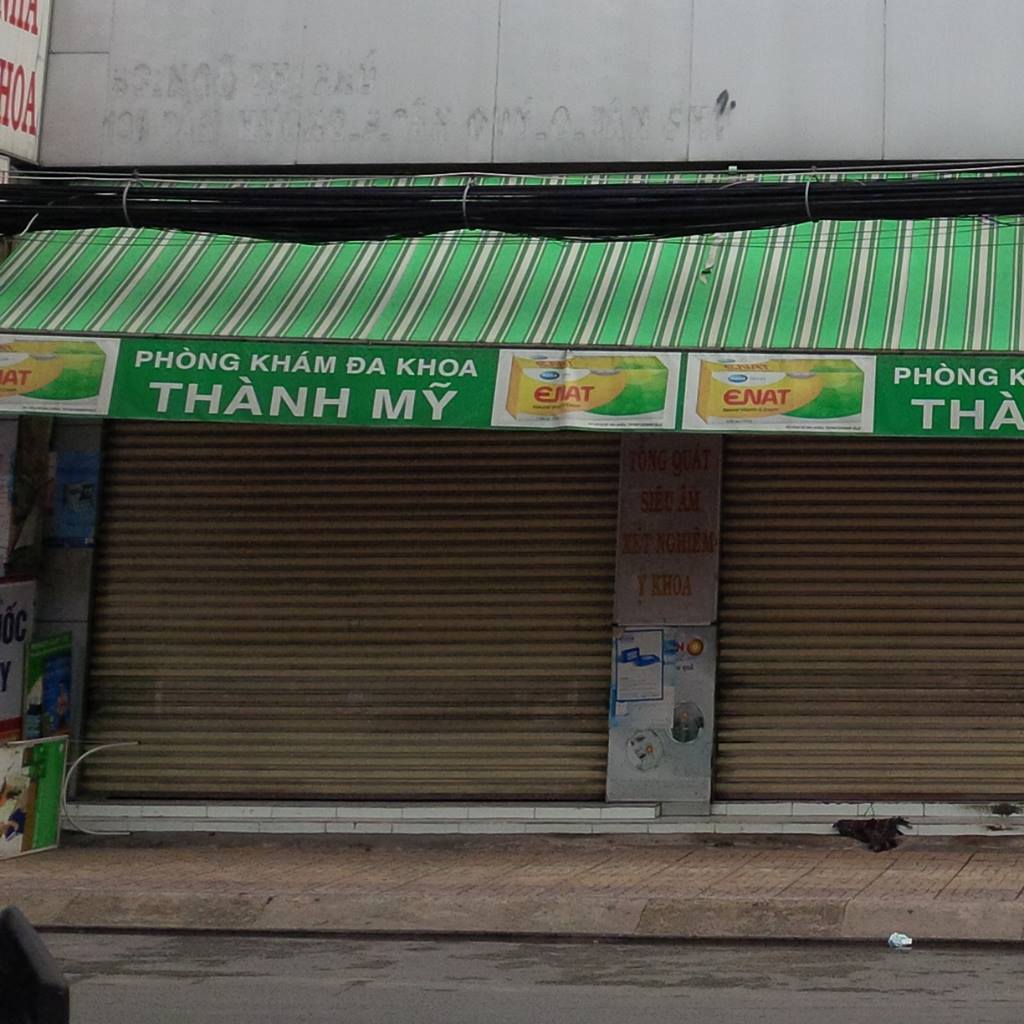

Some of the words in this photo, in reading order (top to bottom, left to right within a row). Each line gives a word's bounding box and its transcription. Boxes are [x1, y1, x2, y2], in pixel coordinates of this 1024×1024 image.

[134, 347, 241, 371] PHÒNG
[250, 351, 337, 374] KHÁM
[346, 357, 386, 375] ĐA
[396, 358, 478, 377] KHOA
[893, 363, 999, 386] PHÒNG
[149, 376, 350, 419] THÀNH
[371, 381, 459, 421] MỸ
[723, 388, 791, 406] ENAT
[651, 575, 693, 597] KHOA
